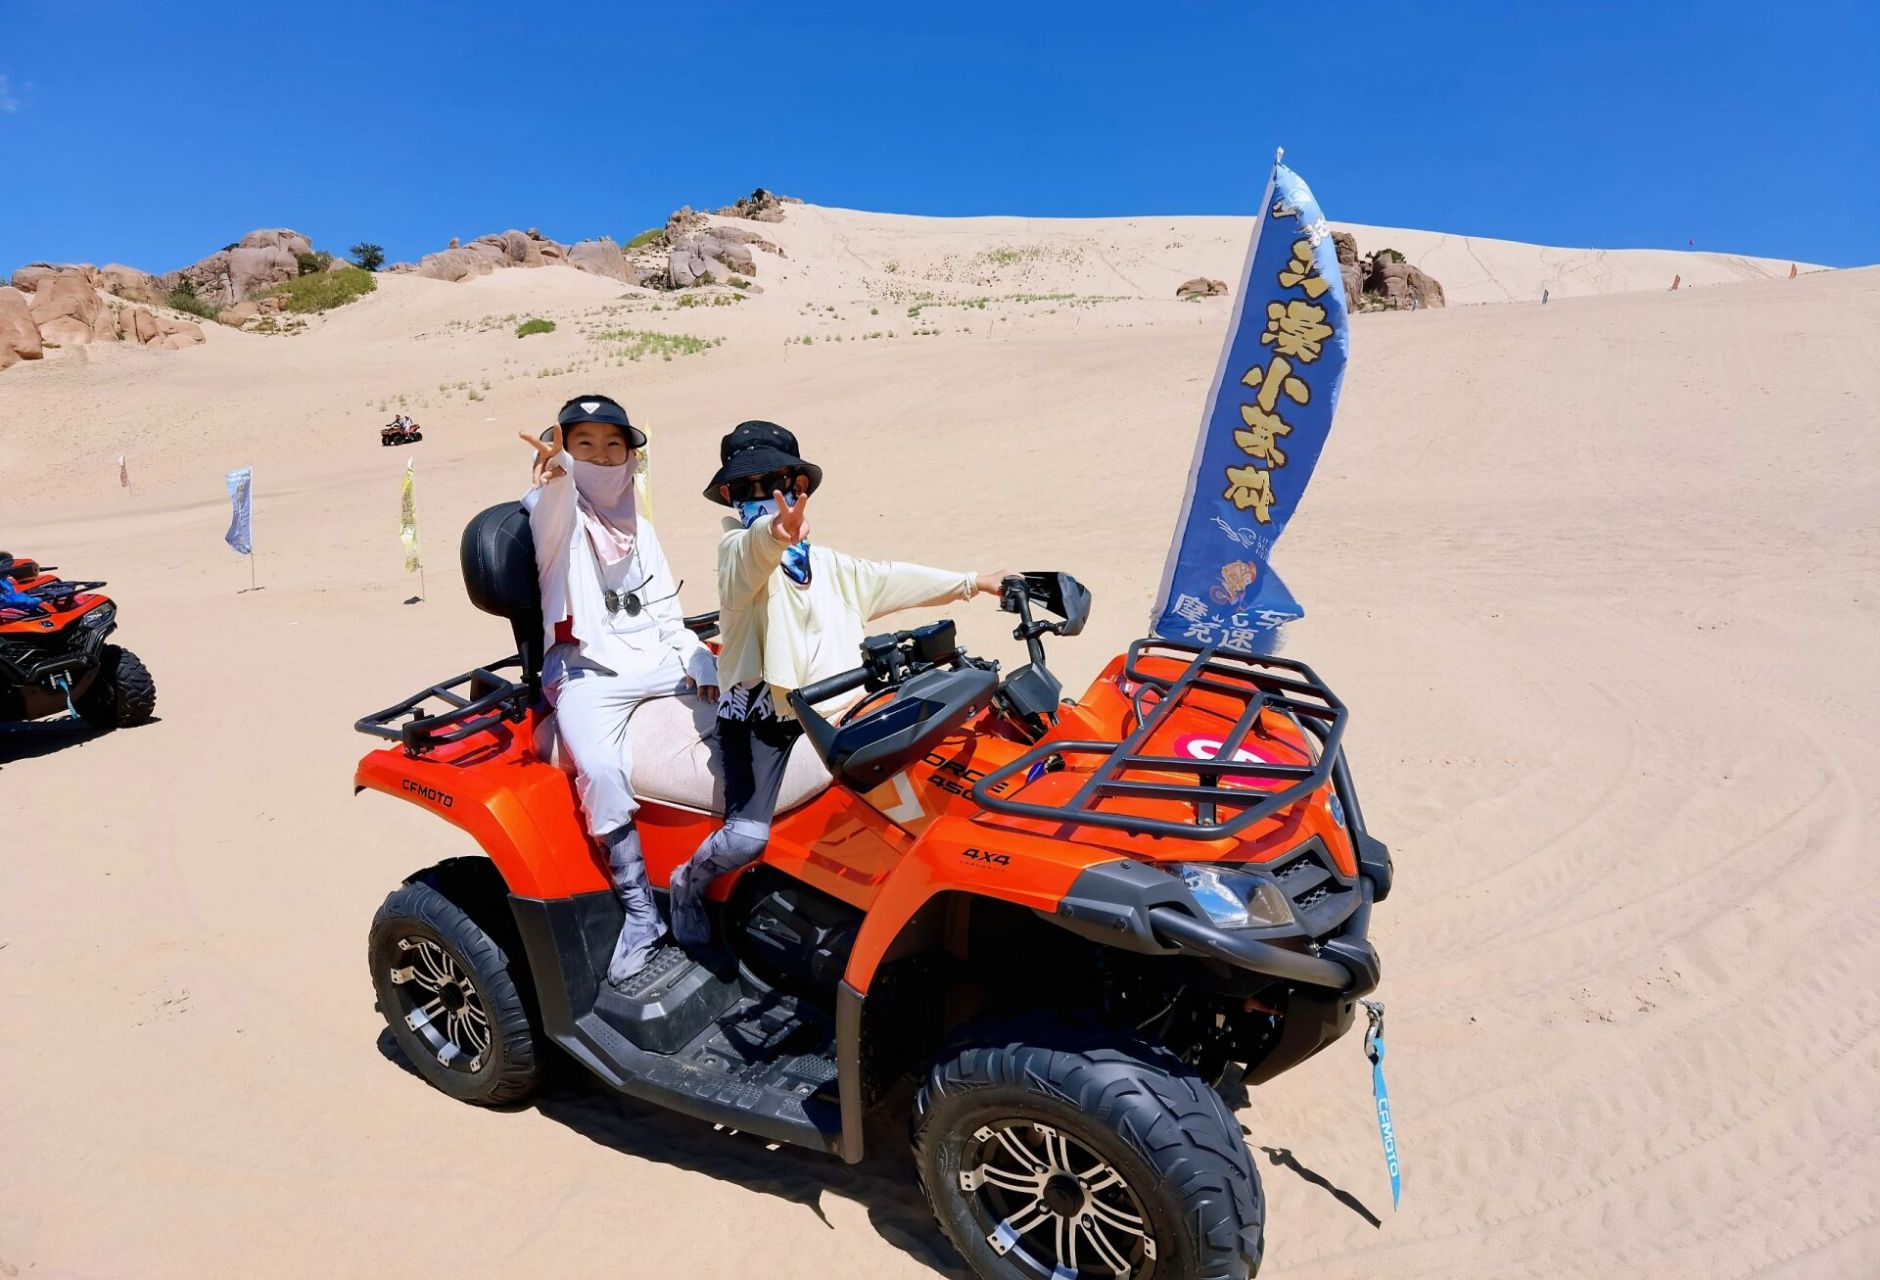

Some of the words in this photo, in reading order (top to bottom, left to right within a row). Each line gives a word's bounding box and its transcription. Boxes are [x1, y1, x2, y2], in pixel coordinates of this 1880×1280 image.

[402, 778, 454, 808] CFMOTO
[923, 752, 1009, 793] ORCE
[1377, 1097, 1398, 1178] CFMOTO
